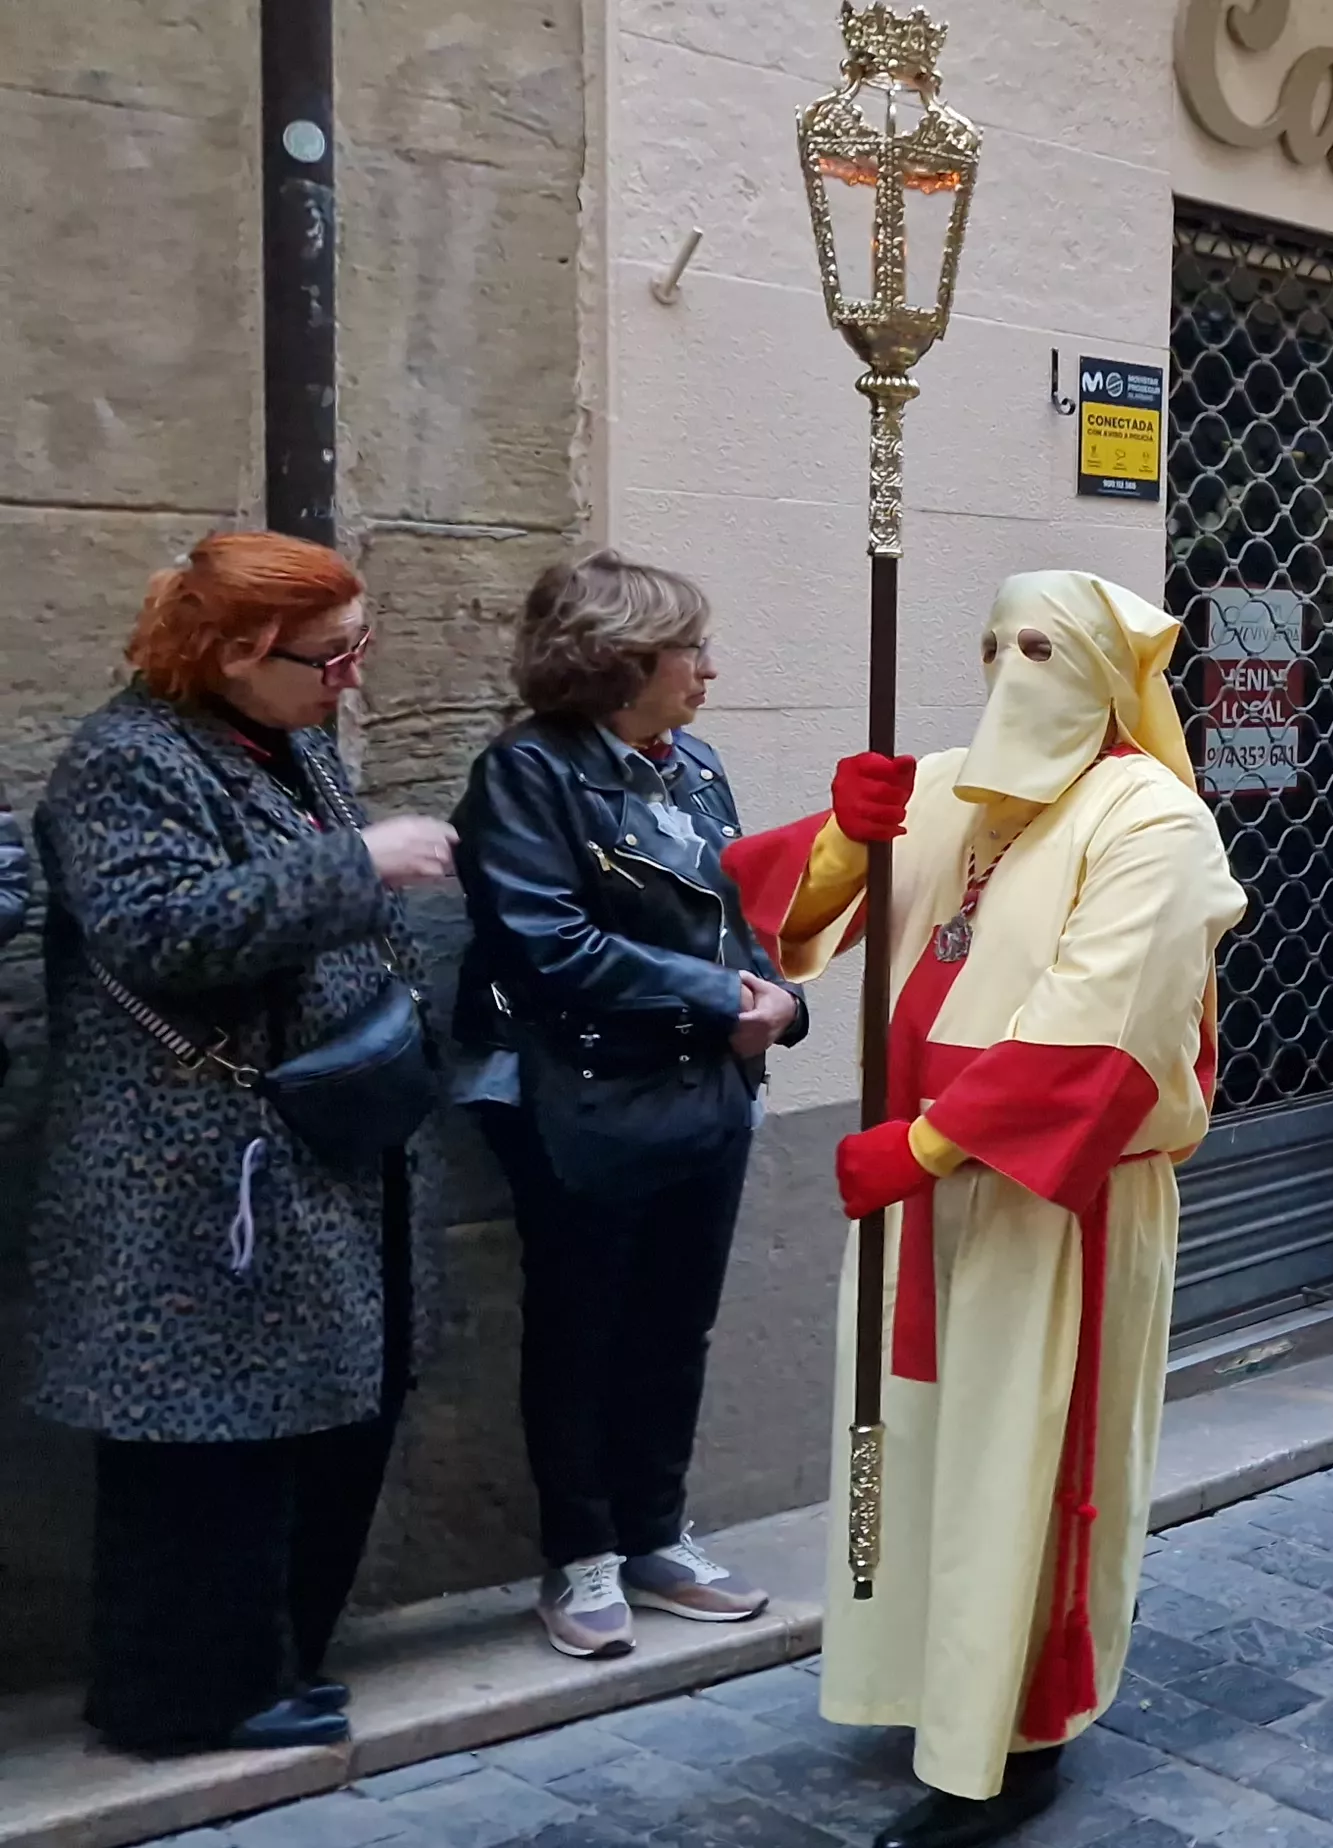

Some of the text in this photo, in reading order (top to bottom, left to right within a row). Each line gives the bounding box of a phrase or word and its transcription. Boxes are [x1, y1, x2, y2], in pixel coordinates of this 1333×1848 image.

[1087, 414, 1154, 433] CONECTADA
[1087, 428, 1102, 437] CON
[1222, 700, 1286, 724] LOCAL
